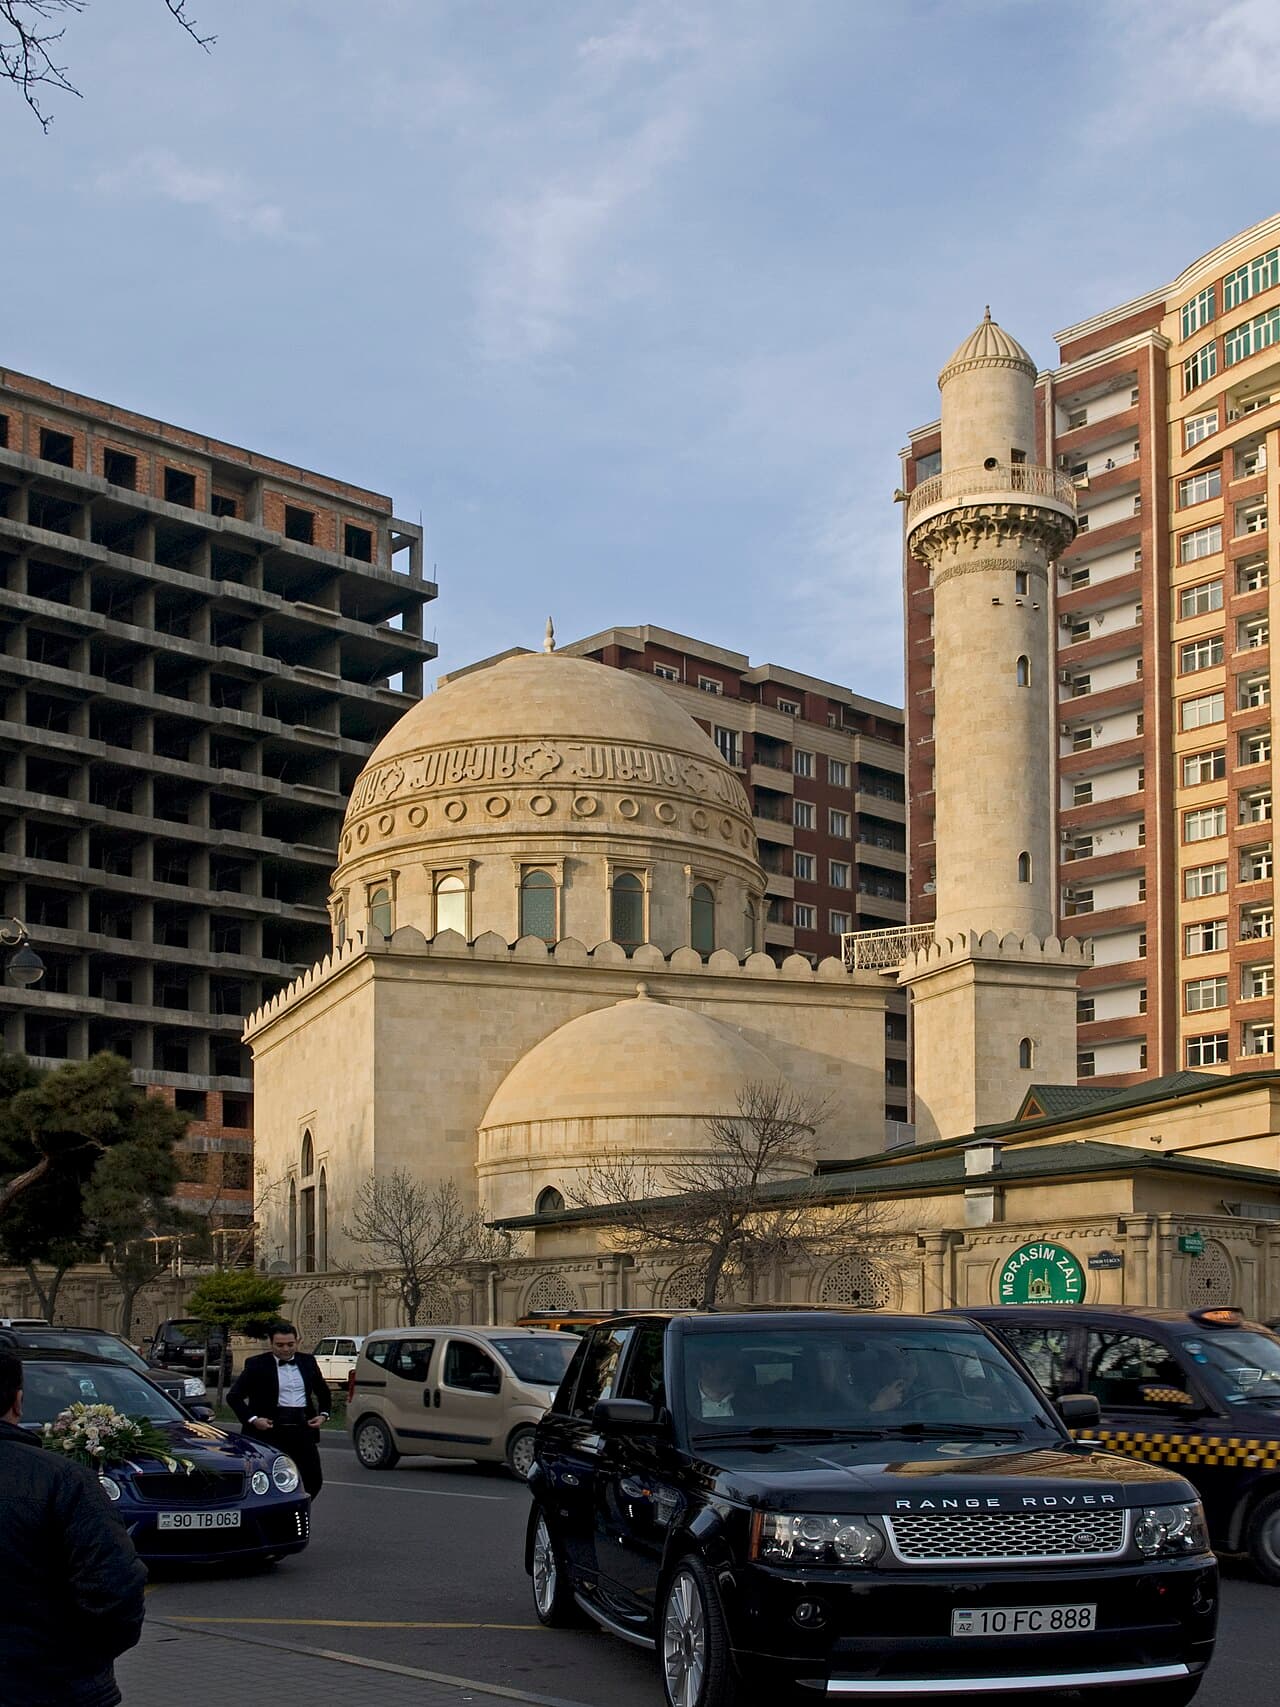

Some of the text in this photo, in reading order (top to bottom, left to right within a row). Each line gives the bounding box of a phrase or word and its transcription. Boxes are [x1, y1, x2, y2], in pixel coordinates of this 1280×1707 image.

[1056, 1256, 1078, 1292] ZALI
[896, 1494, 1115, 1509] RANGE ROVER
[173, 1514, 192, 1527] 90
[196, 1513, 213, 1527] TB
[216, 1512, 239, 1526] 063
[958, 1608, 1091, 1632] AZ 10 FC 888
